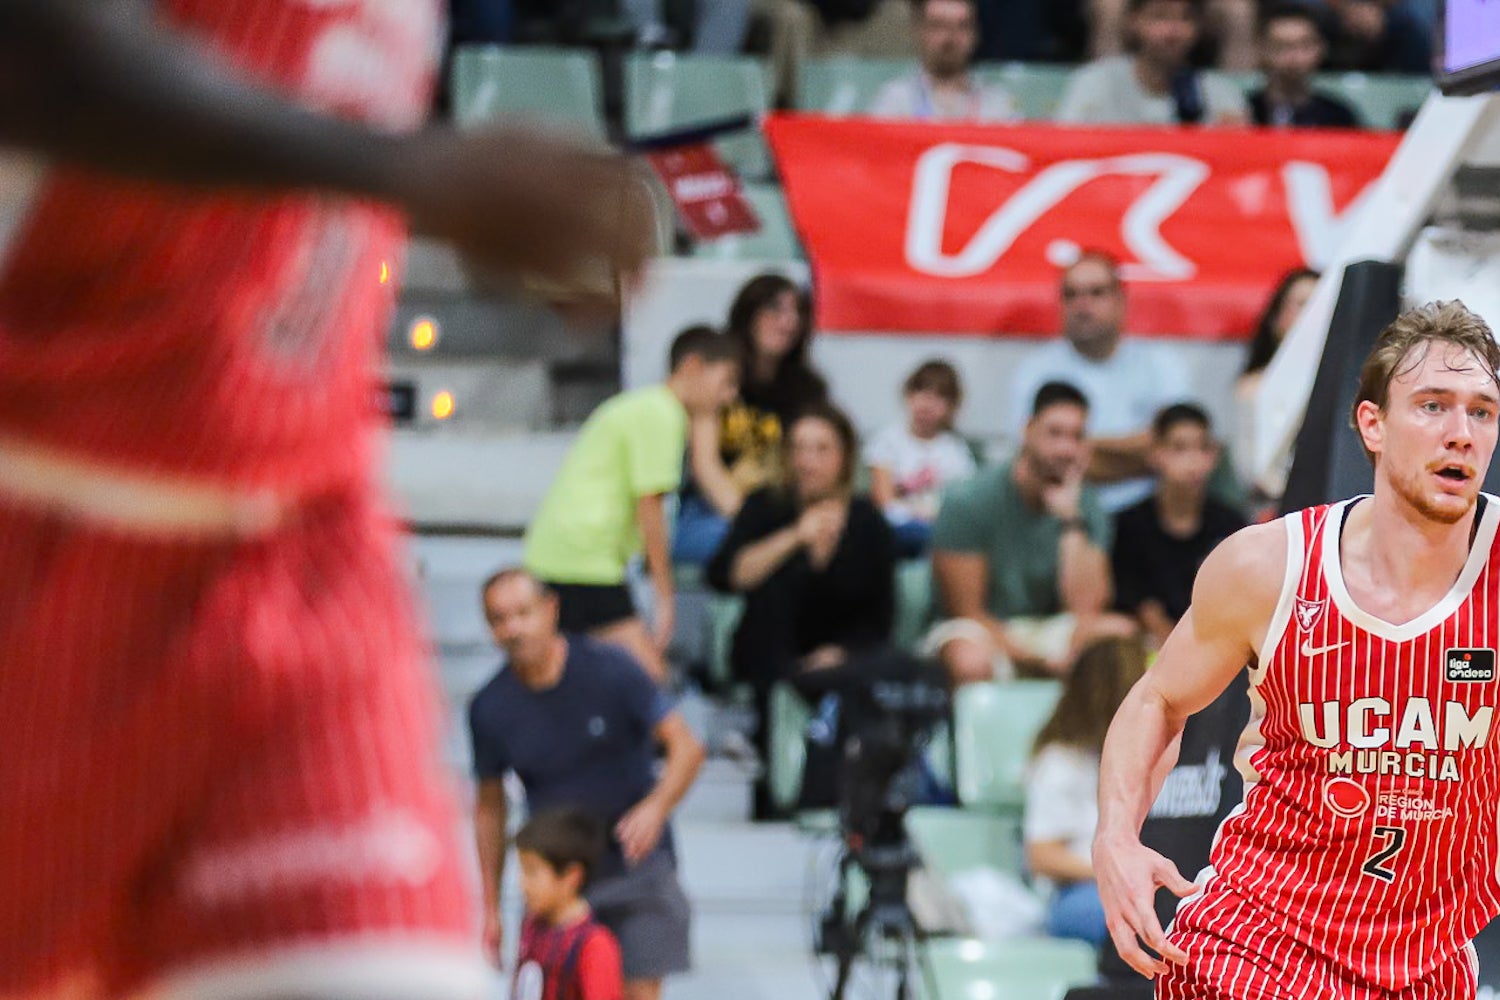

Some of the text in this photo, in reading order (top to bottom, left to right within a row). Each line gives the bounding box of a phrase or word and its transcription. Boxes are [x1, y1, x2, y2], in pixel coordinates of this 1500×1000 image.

[1300, 696, 1495, 751] UCAM
[1328, 750, 1460, 782] MURCIA
[1377, 805, 1454, 821] DE MURCIA
[1362, 826, 1407, 884] 2
